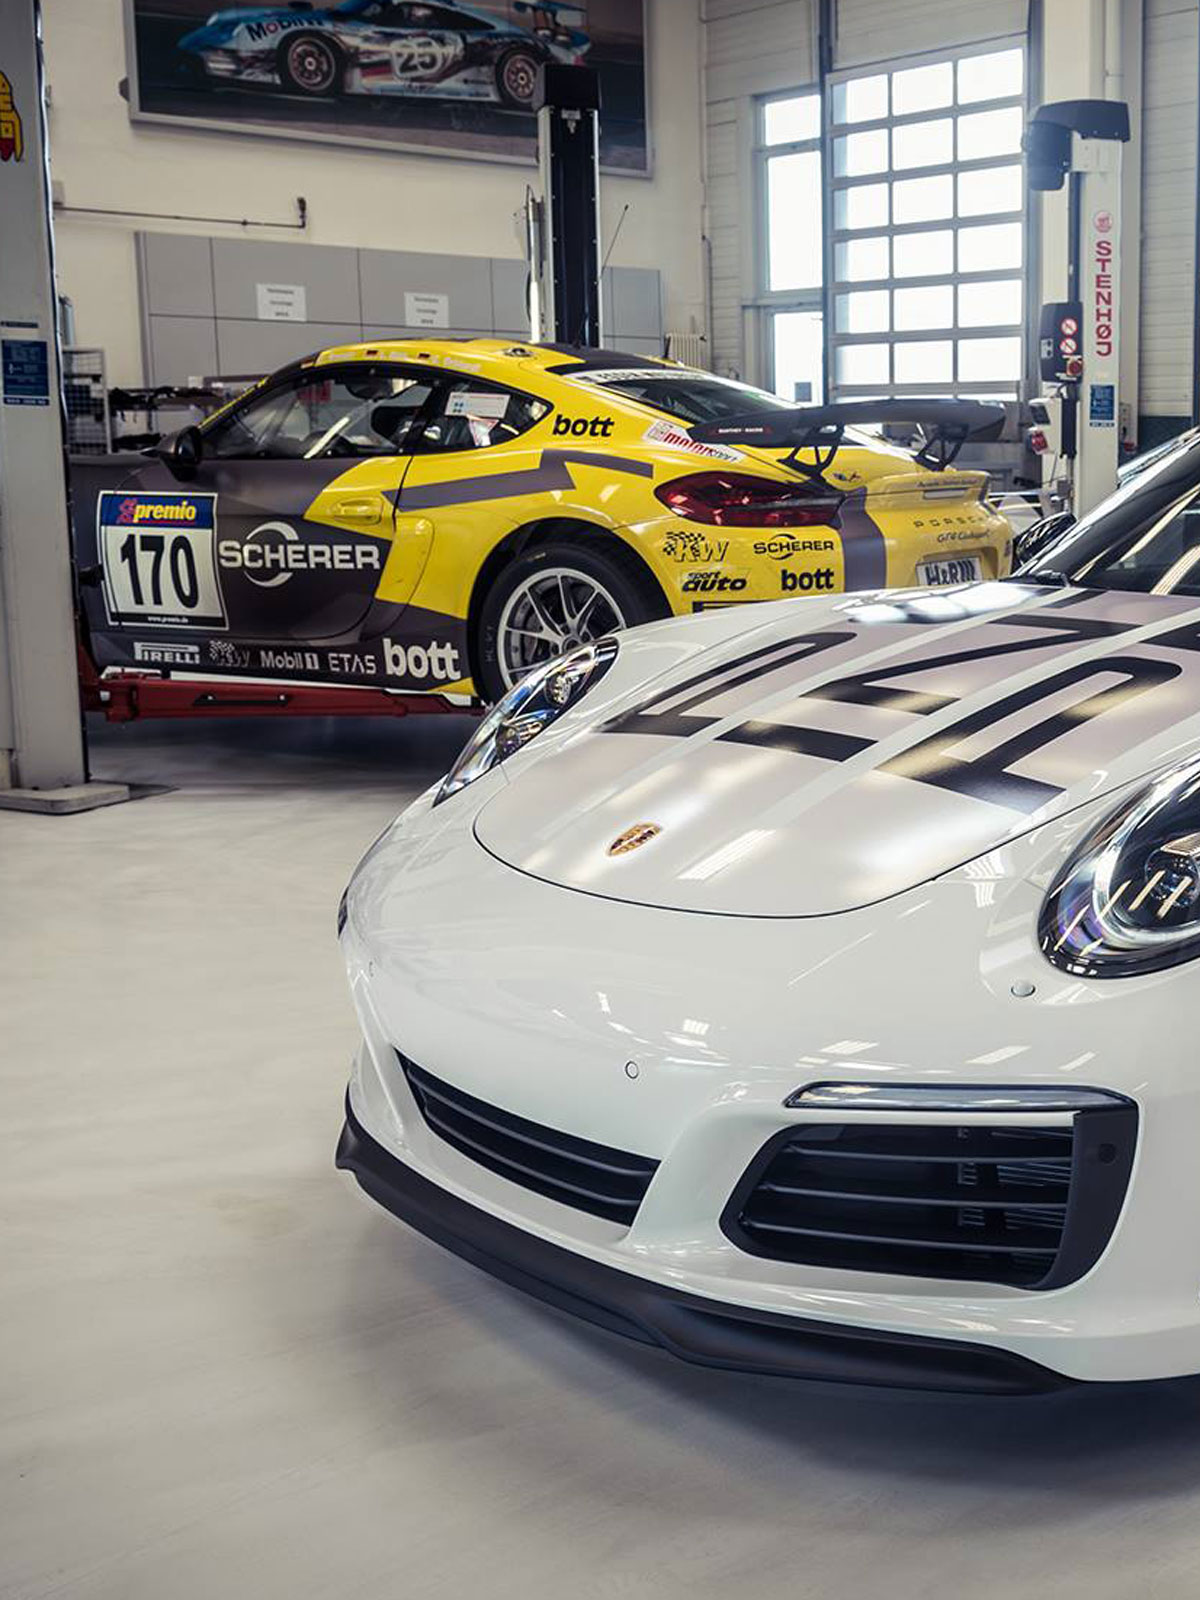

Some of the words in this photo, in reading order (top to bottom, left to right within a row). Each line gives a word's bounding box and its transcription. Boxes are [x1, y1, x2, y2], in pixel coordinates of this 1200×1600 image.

[396, 42, 438, 72] 25
[1095, 240, 1112, 357] STENHØJ
[552, 413, 615, 437] bott
[132, 500, 197, 523] premio
[218, 540, 381, 569] SCHERER
[753, 540, 835, 555] SCHERER
[120, 533, 199, 609] 170
[780, 568, 835, 592] bott
[682, 575, 748, 593] auto
[133, 642, 200, 664] PIRELLI
[260, 650, 303, 670] Mobil
[328, 653, 377, 674] ETAS
[382, 637, 462, 680] bott
